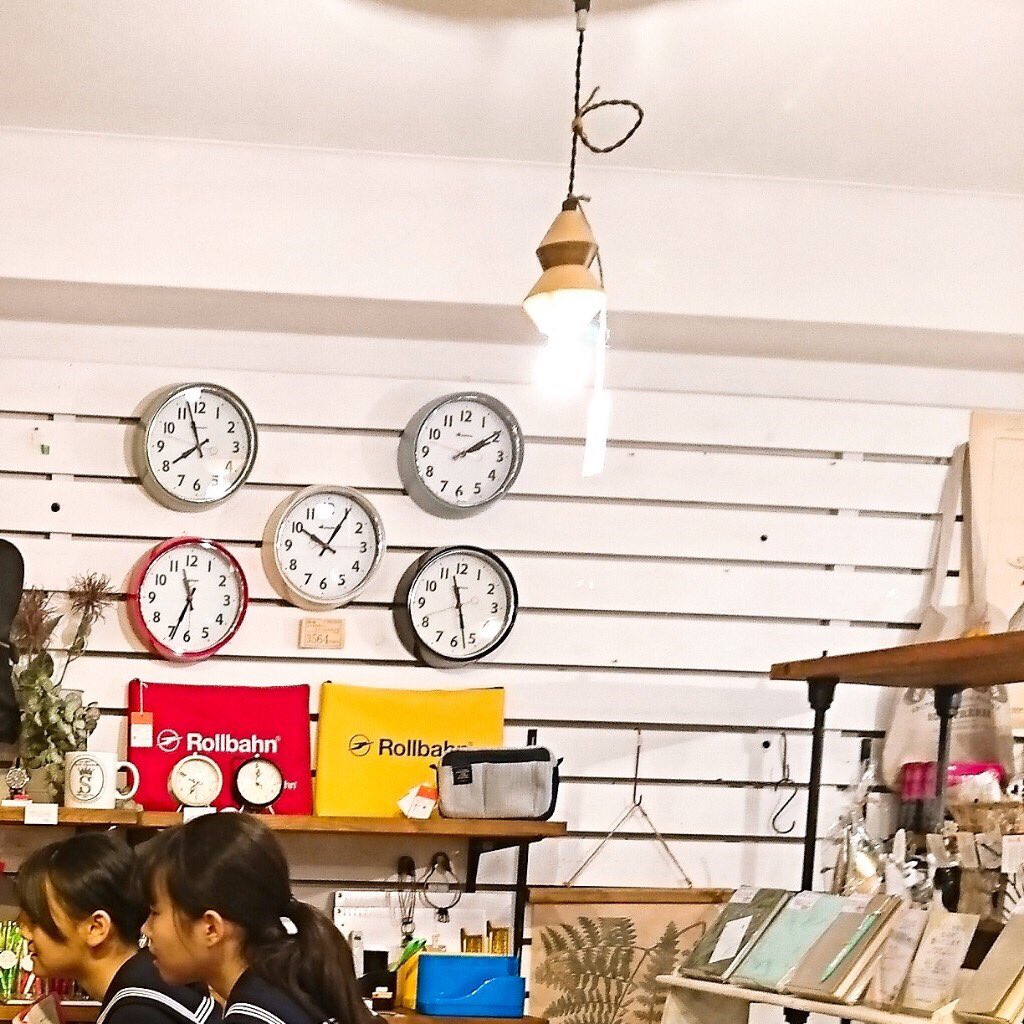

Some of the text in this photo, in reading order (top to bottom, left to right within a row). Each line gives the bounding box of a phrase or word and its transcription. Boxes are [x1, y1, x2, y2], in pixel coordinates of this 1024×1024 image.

[178, 407, 186, 420] 11
[194, 401, 206, 414] 12
[444, 415, 453, 427] 11
[460, 410, 472, 422] 12
[163, 422, 175, 434] 10
[227, 421, 235, 433] 2
[429, 428, 441, 440] 10
[156, 440, 165, 452] 9
[232, 441, 240, 453] 3
[422, 445, 430, 458] 9
[496, 451, 504, 462] 3
[162, 460, 170, 472] 8
[425, 465, 434, 478] 8
[177, 474, 185, 487] 7
[488, 469, 496, 481] 4
[193, 479, 201, 491] 6
[440, 480, 449, 492] 7
[455, 485, 463, 497] 6
[473, 483, 481, 494] 5
[306, 508, 315, 520] 11
[292, 521, 303, 533] 10
[355, 522, 363, 534] 2
[285, 539, 293, 551] 9
[359, 541, 367, 554] 3
[170, 560, 179, 572] 11
[186, 555, 198, 567] 12
[289, 559, 297, 571] 8
[352, 560, 360, 572] 4
[440, 567, 449, 580] 11
[456, 563, 469, 575] 12
[155, 574, 167, 586] 10
[218, 575, 226, 587] 2
[304, 573, 312, 585] 7
[319, 577, 328, 590] 6
[338, 574, 346, 586] 5
[425, 580, 437, 592] 10
[487, 583, 495, 595] 2
[148, 591, 156, 604] 9
[223, 594, 231, 607] 3
[418, 597, 426, 609] 9
[491, 602, 498, 614] 3
[153, 611, 161, 623] 8
[215, 613, 224, 625] 4
[422, 616, 429, 628] 8
[168, 625, 176, 638] 7
[183, 630, 191, 643] 6
[201, 627, 209, 639] 5
[436, 631, 444, 642] 7
[450, 636, 458, 648] 6
[468, 633, 476, 644] 5
[187, 732, 277, 753] Rollbahn
[378, 738, 467, 757] Rollbah
[77, 775, 92, 794] S
